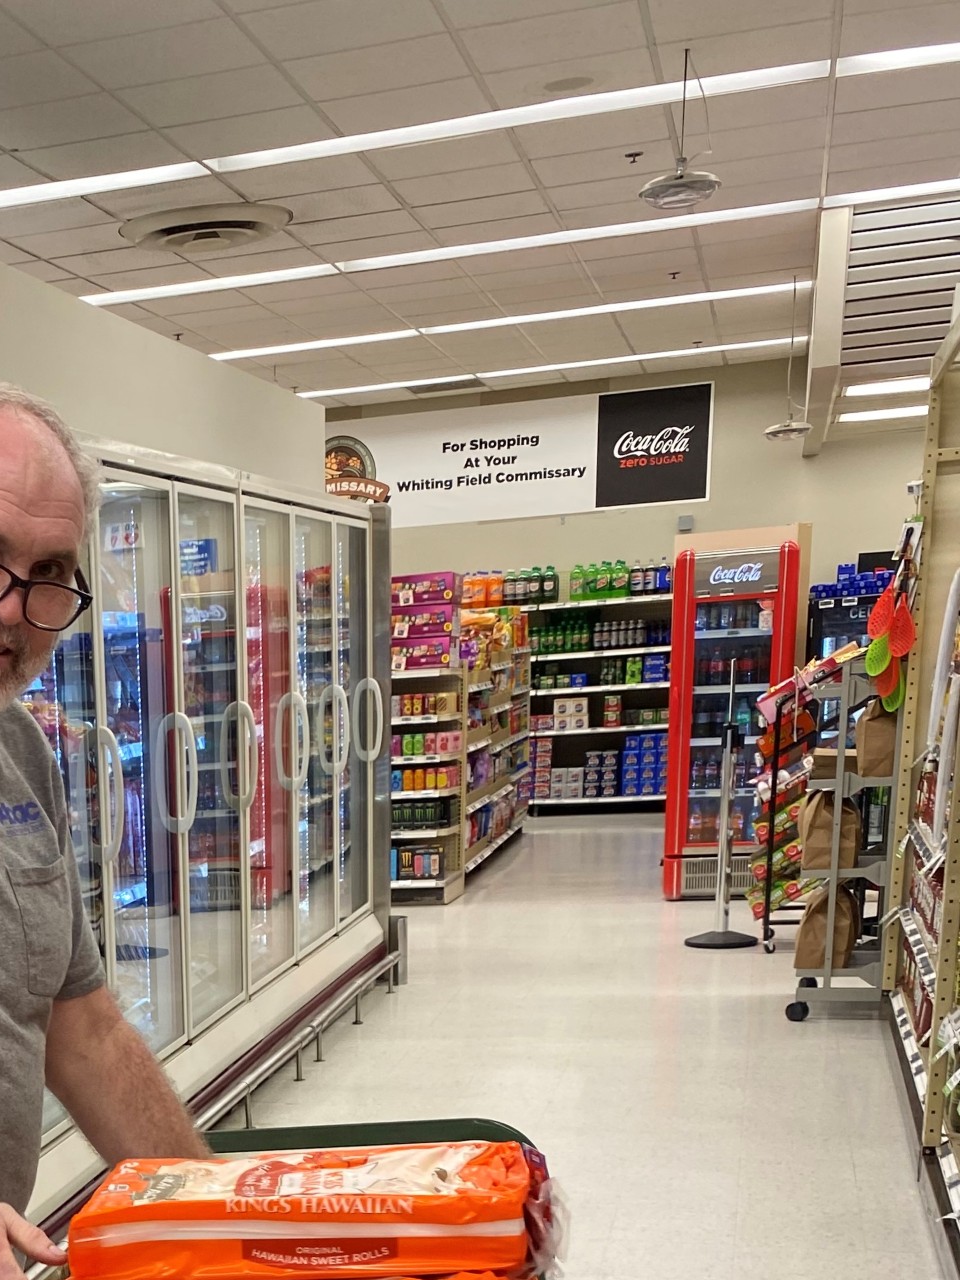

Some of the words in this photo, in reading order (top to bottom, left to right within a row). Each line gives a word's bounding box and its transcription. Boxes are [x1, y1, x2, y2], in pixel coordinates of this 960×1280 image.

[442, 441, 466, 454] For
[469, 435, 540, 450] Shopping
[463, 457, 480, 469] At
[484, 455, 518, 467] Your
[619, 456, 648, 469] zero
[649, 454, 684, 466] SUGAR
[397, 477, 453, 493] Whiting
[456, 473, 491, 487] Field
[495, 466, 587, 483] Commissary
[326, 481, 384, 497] MISSARY
[300, 1197, 414, 1214] HAWAIIAN
[251, 1248, 309, 1265] HAWAIIAN
[310, 1256, 349, 1266] SWEET
[352, 1247, 390, 1263] ROLLS
[295, 1246, 343, 1255] ORIGINAL
